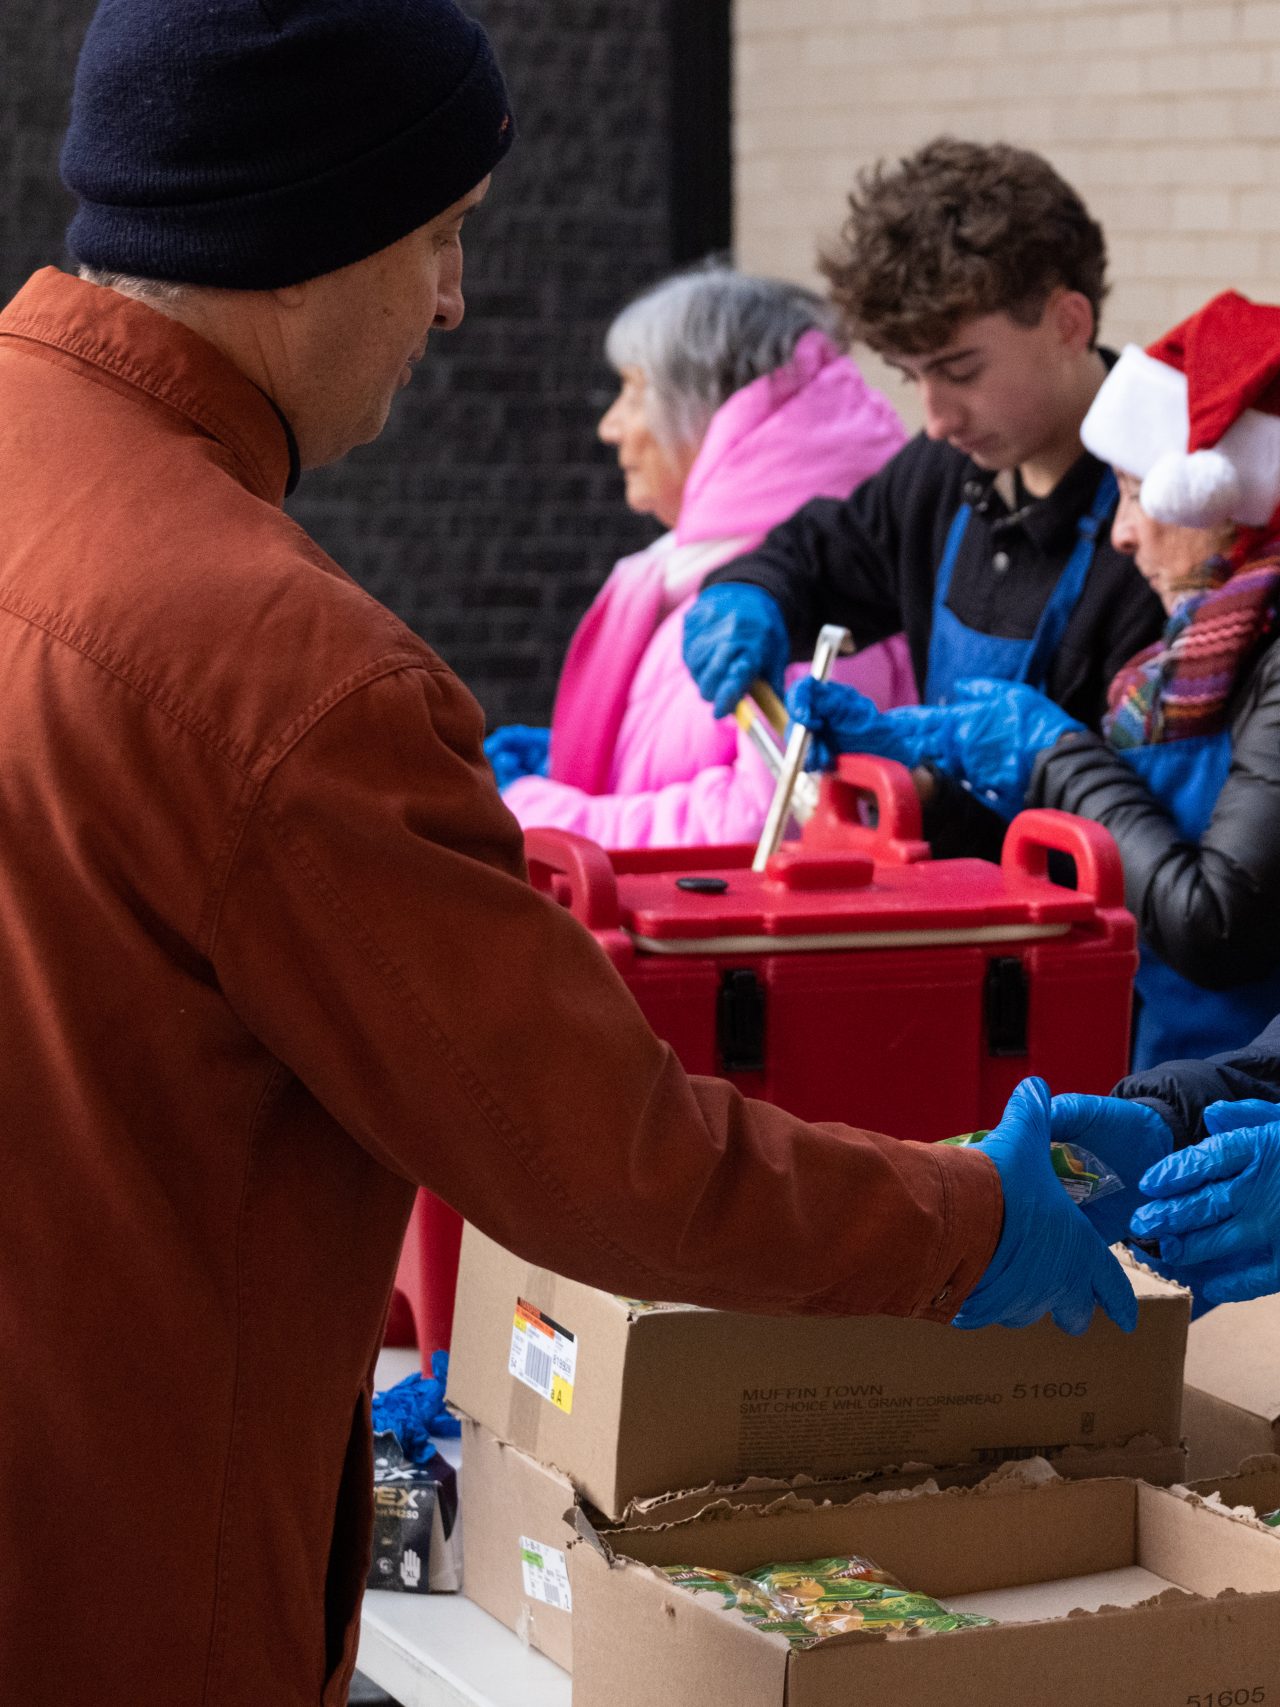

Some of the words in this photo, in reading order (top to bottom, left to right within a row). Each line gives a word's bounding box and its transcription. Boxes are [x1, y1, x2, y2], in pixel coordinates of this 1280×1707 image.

[743, 1388, 817, 1401] MUFFIN
[825, 1384, 884, 1398] TOWN
[1012, 1381, 1088, 1400] 51605
[773, 1400, 829, 1414] CHOICE
[868, 1396, 913, 1409] GRAIN
[1185, 1686, 1266, 1707] 51605
